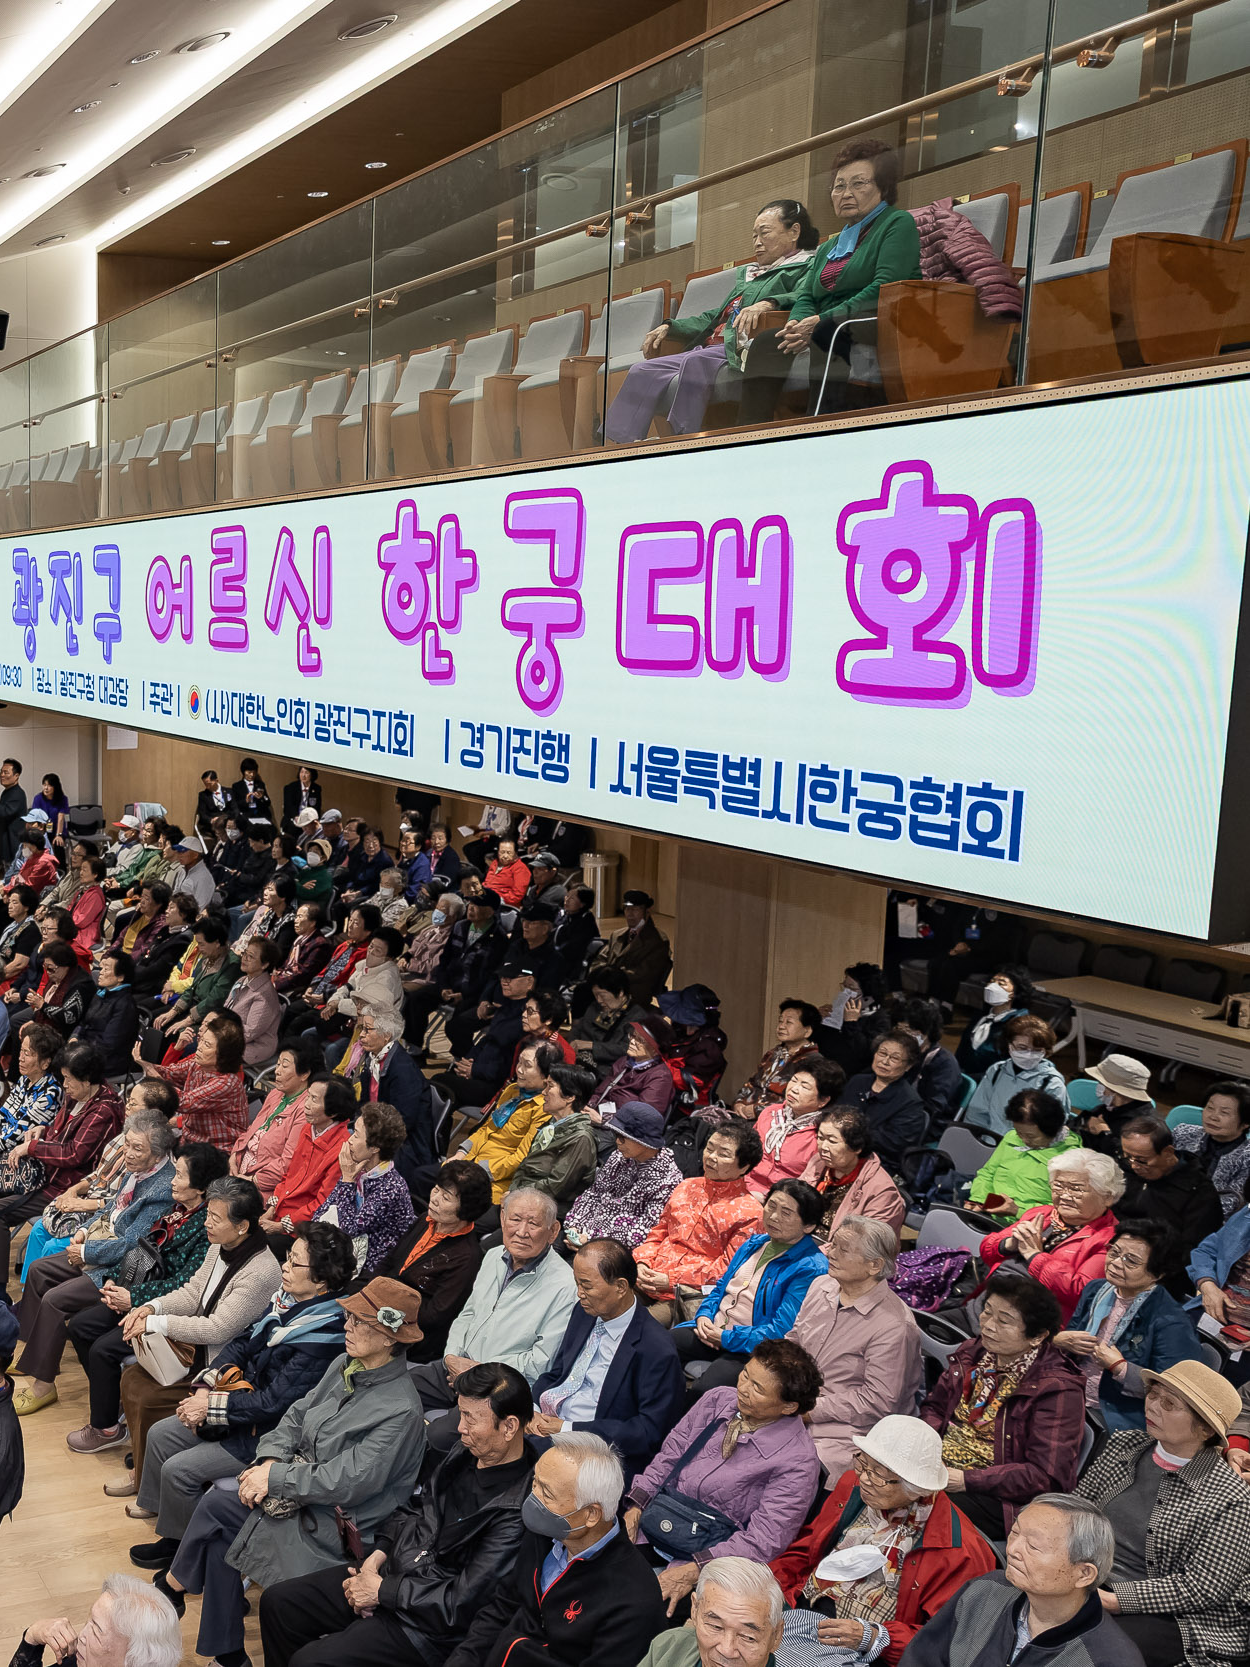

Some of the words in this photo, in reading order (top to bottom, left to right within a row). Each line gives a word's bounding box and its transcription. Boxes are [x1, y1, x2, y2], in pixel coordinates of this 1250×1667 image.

[12, 544, 122, 665] 광진구
[145, 524, 333, 678] 어르신
[36, 667, 53, 694] 장소
[60, 670, 95, 702] 광진구청
[98, 675, 130, 708] 대강당
[149, 681, 174, 716] 주관
[205, 688, 311, 740] (사)대한노인회
[314, 702, 415, 758] 광진구지회
[459, 720, 571, 784] 경기진행
[609, 741, 1025, 863] 서울특별시한궁협회
